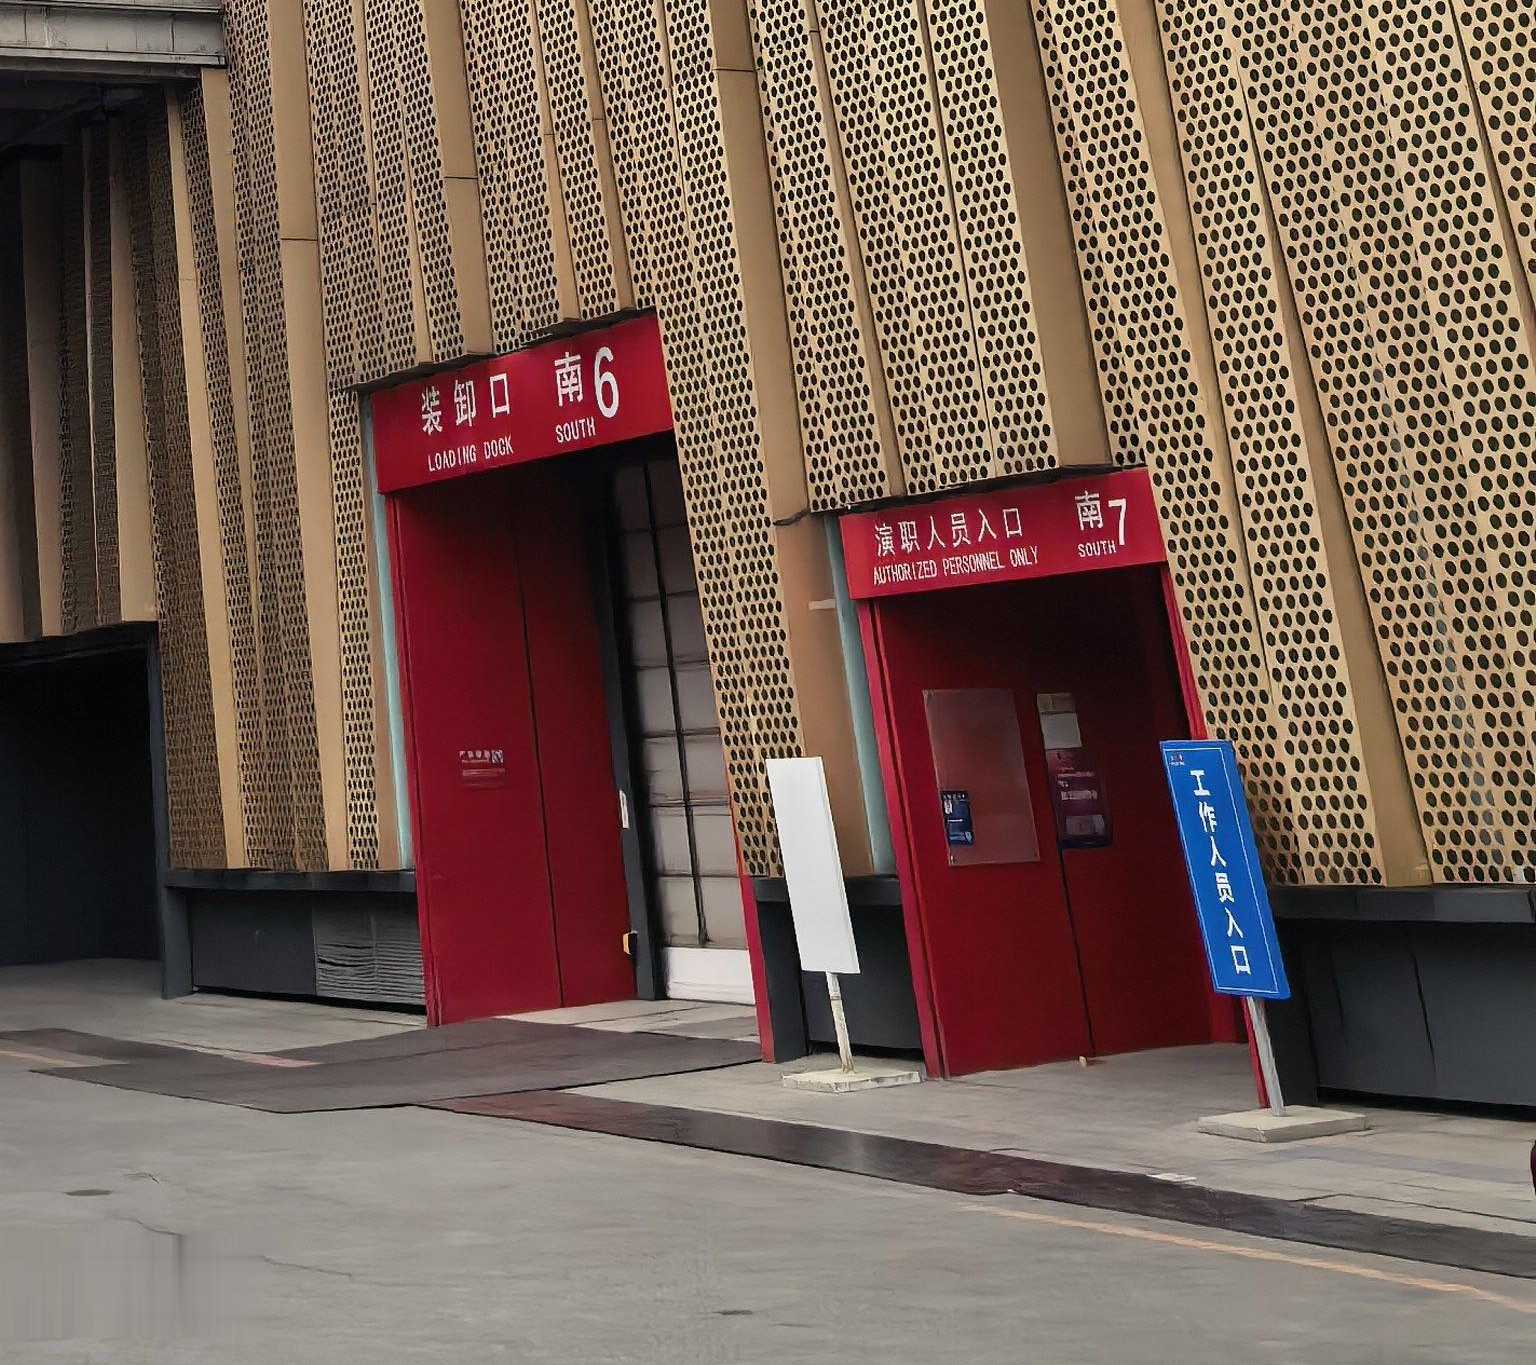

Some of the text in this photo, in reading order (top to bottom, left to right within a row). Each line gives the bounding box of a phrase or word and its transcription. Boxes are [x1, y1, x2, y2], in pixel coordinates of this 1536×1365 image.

[421, 372, 511, 436] 装卸口
[427, 416, 597, 473] LOADING DOCK SOUTH
[874, 507, 1024, 559] 演职人员入口
[873, 539, 1117, 586] AUTHORIZED PERSONNEL ONLY SOUTH
[1189, 769, 1252, 976] 工作人员入口
